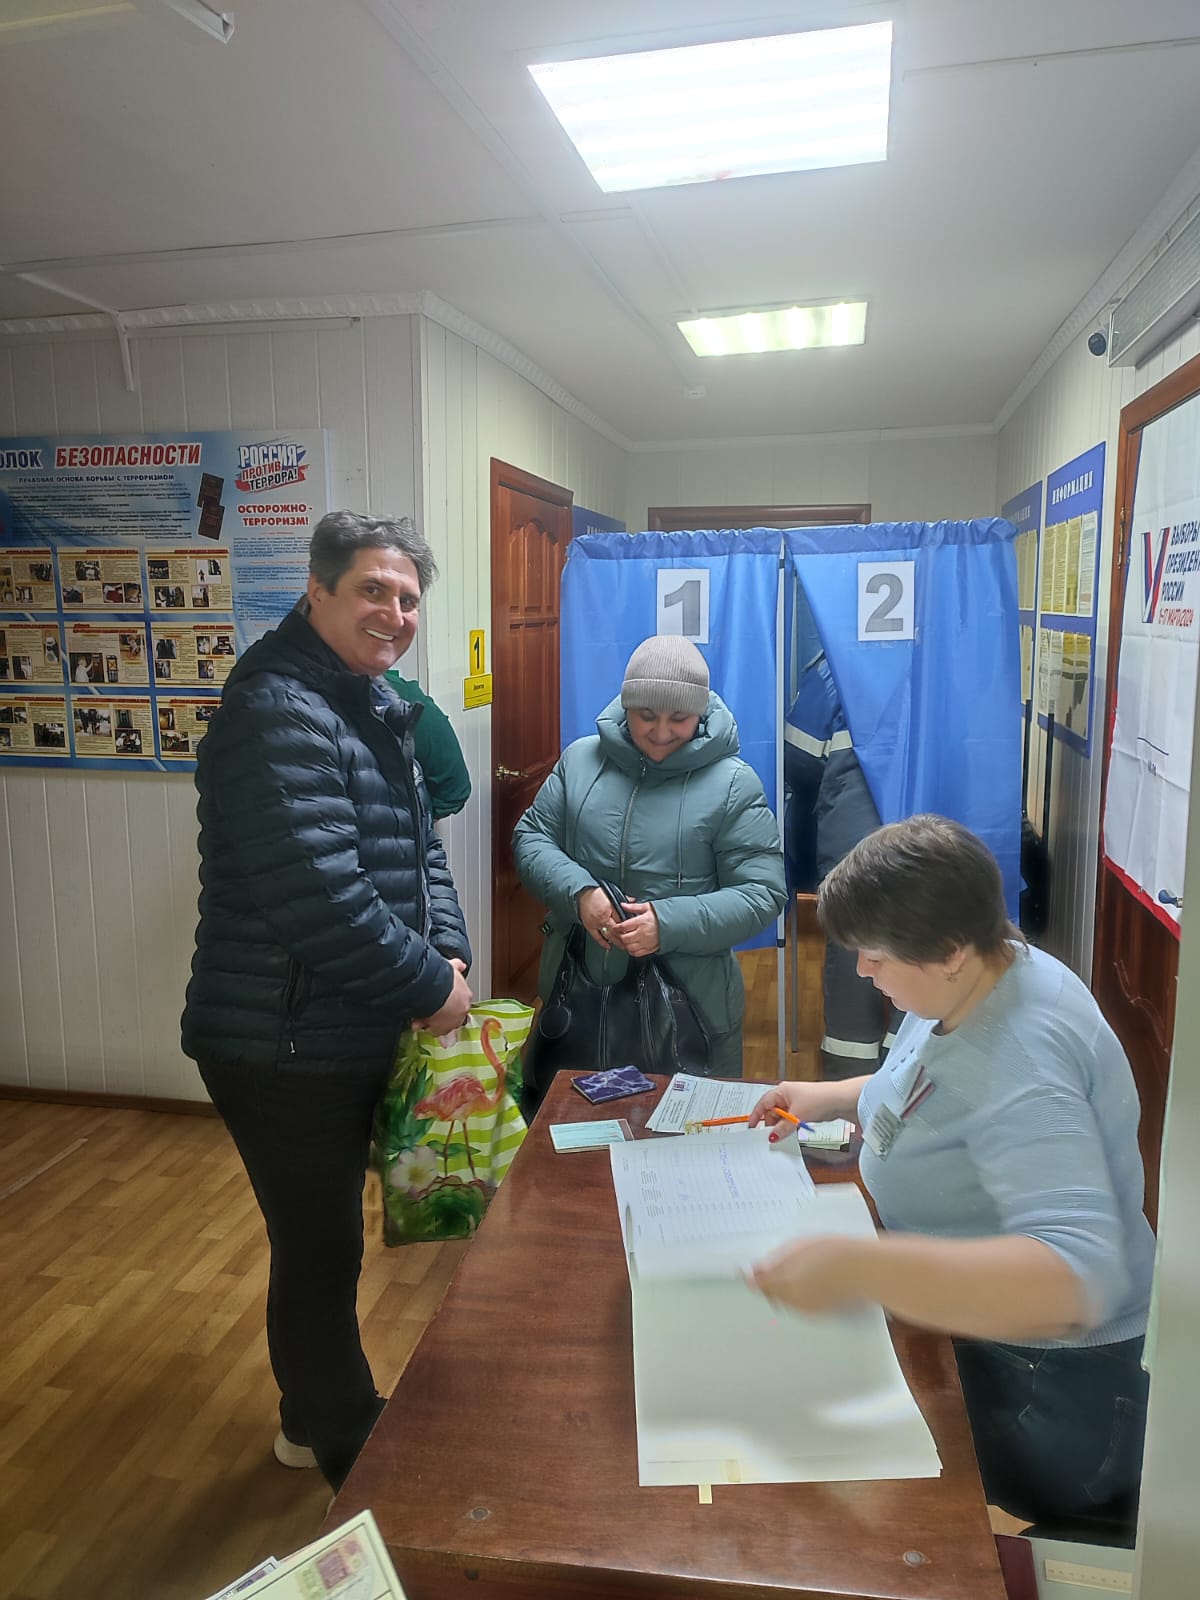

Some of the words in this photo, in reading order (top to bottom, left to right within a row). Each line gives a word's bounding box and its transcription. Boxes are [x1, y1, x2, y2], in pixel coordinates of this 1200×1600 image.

[56, 444, 201, 468] БЕЗОПАСНОСТИ
[239, 445, 298, 468] РОССИЯ
[123, 474, 175, 482] ТЕРРОРИЗМОМ
[242, 461, 281, 480] ПРОТИВ
[249, 468, 297, 491] ТЕРРОРА!
[1052, 470, 1094, 505] ИНФОРМАЦИЯ
[238, 504, 307, 514] ОСТОРОЖНО
[243, 516, 309, 526] ТЕРРОРИЗМ!
[1165, 549, 1200, 576] ПРЕЗИДЕН
[664, 580, 701, 636] 1
[865, 573, 904, 633] 2
[473, 636, 480, 669] 1
